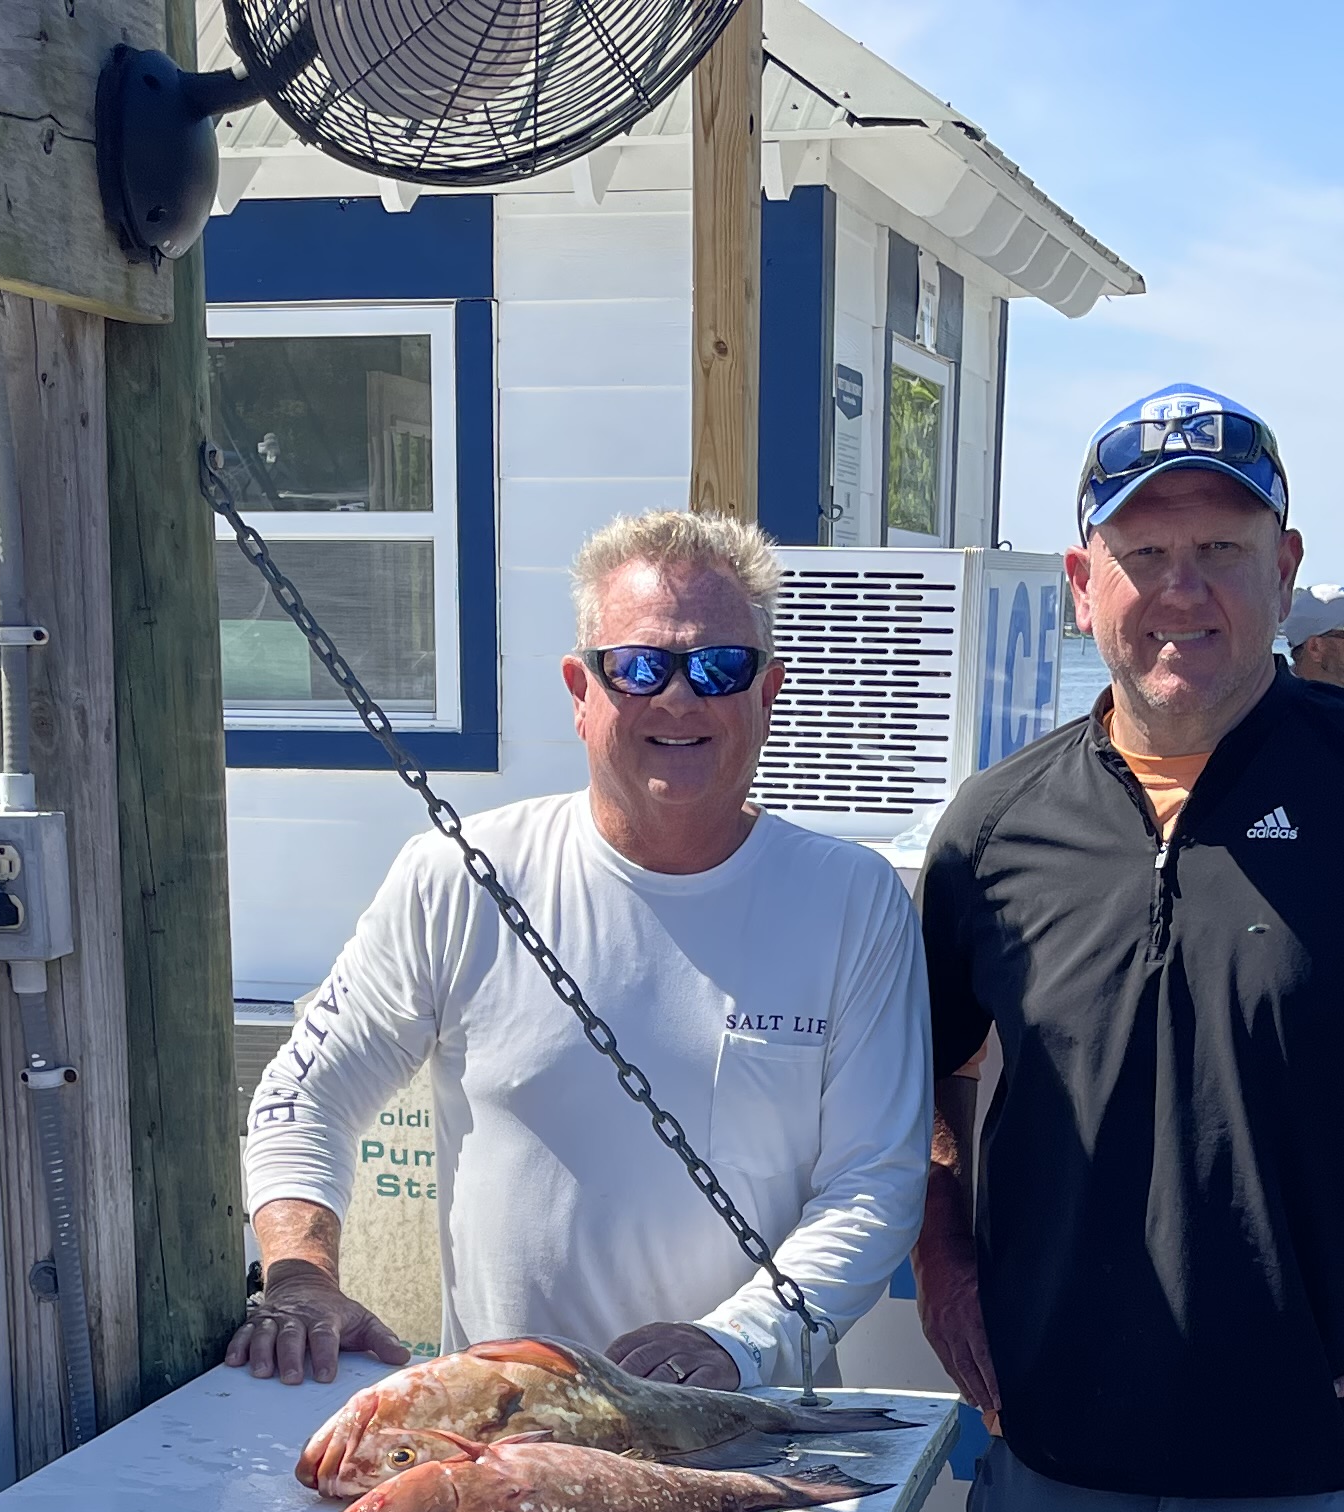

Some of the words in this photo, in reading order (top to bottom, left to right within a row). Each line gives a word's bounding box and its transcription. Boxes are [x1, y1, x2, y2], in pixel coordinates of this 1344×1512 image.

[978, 581, 1057, 771] ICE
[1246, 827, 1298, 840] adidas
[725, 1014, 784, 1031] SALT
[793, 1016, 828, 1035] LIF
[379, 1108, 430, 1128] oldi
[361, 1140, 435, 1167] Pum
[376, 1173, 437, 1199] Sta
